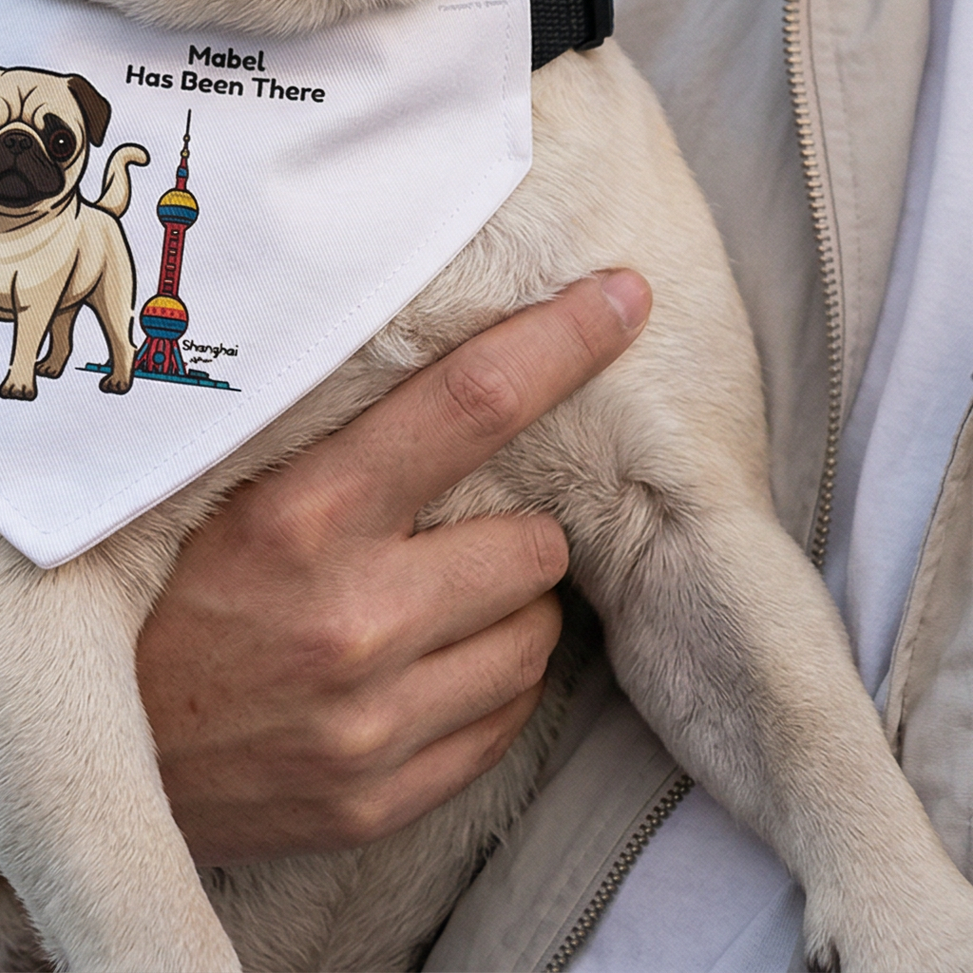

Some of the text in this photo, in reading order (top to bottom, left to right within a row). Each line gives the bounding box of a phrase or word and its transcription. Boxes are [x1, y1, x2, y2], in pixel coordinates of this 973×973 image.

[187, 44, 266, 73] Mabel
[125, 64, 326, 103] Has Been There
[182, 339, 239, 358] Shanghai
